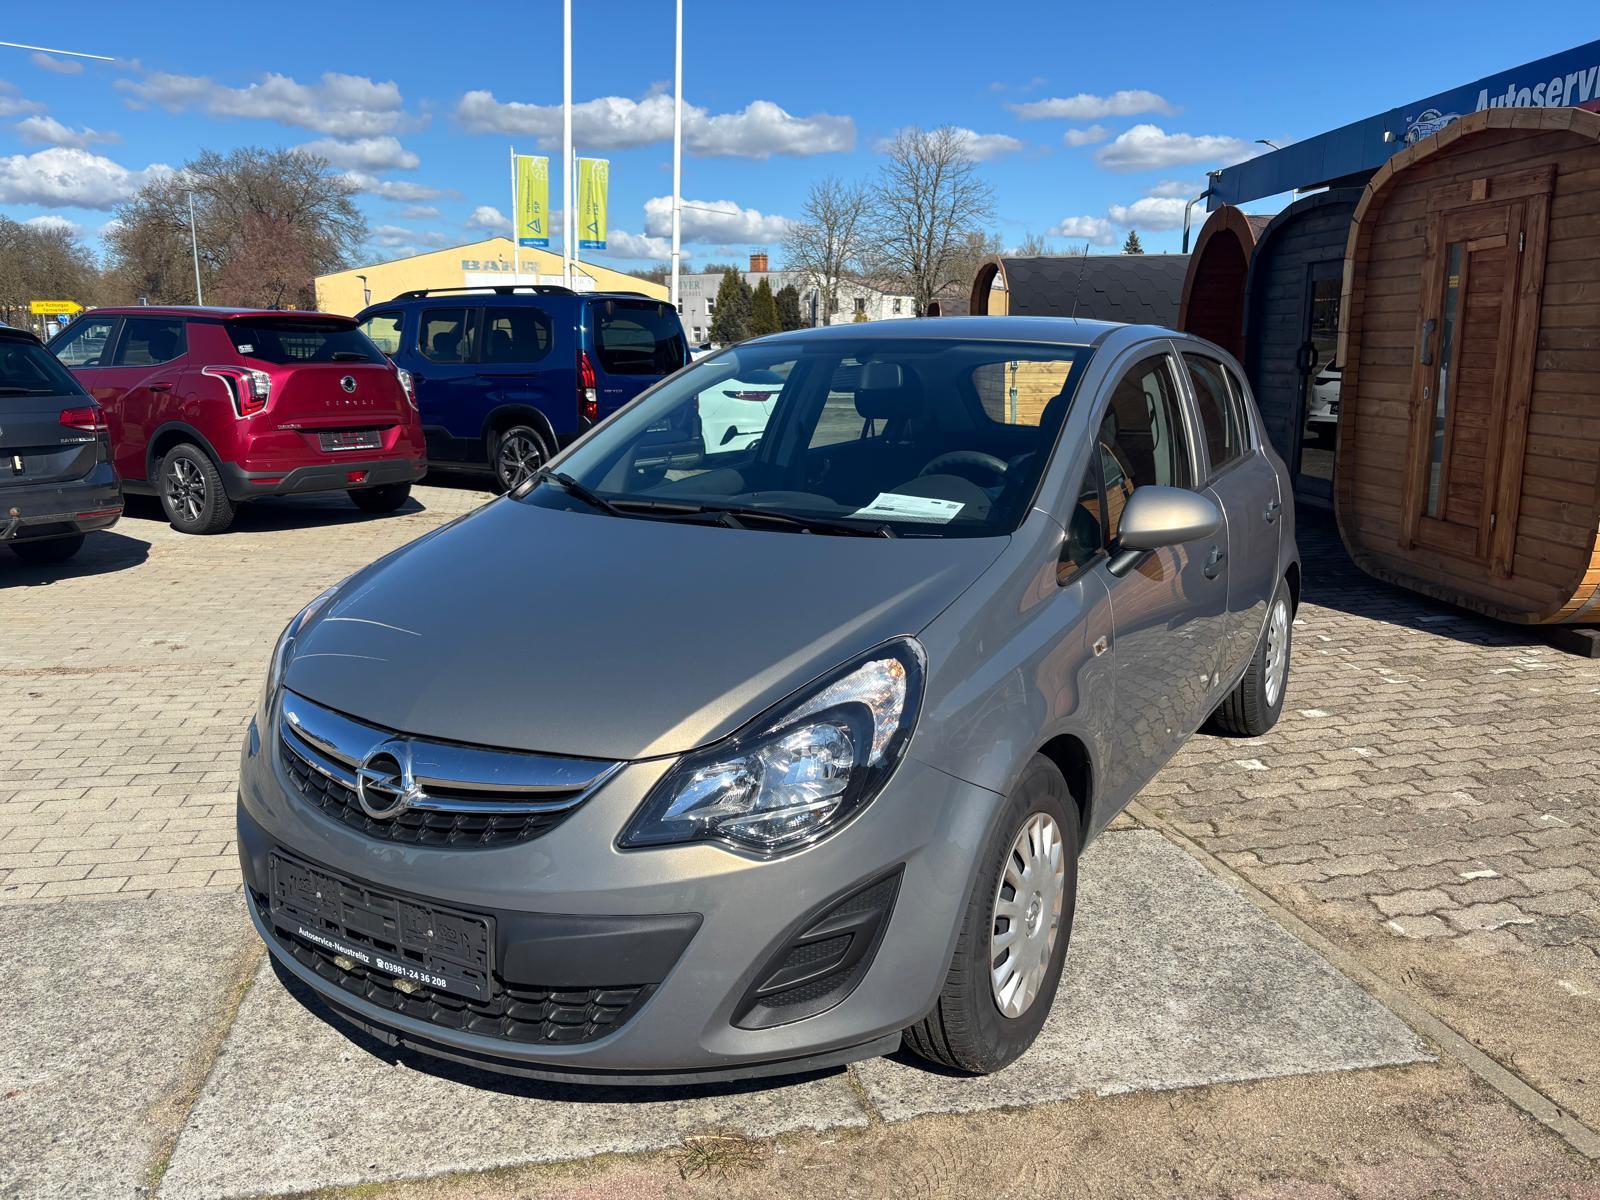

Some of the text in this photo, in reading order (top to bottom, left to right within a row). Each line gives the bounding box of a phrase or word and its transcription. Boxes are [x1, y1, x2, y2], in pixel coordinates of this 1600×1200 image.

[298, 926, 370, 963] Autoservice-Neustrelitz
[420, 972, 430, 983] 36
[431, 976, 447, 988] 208
